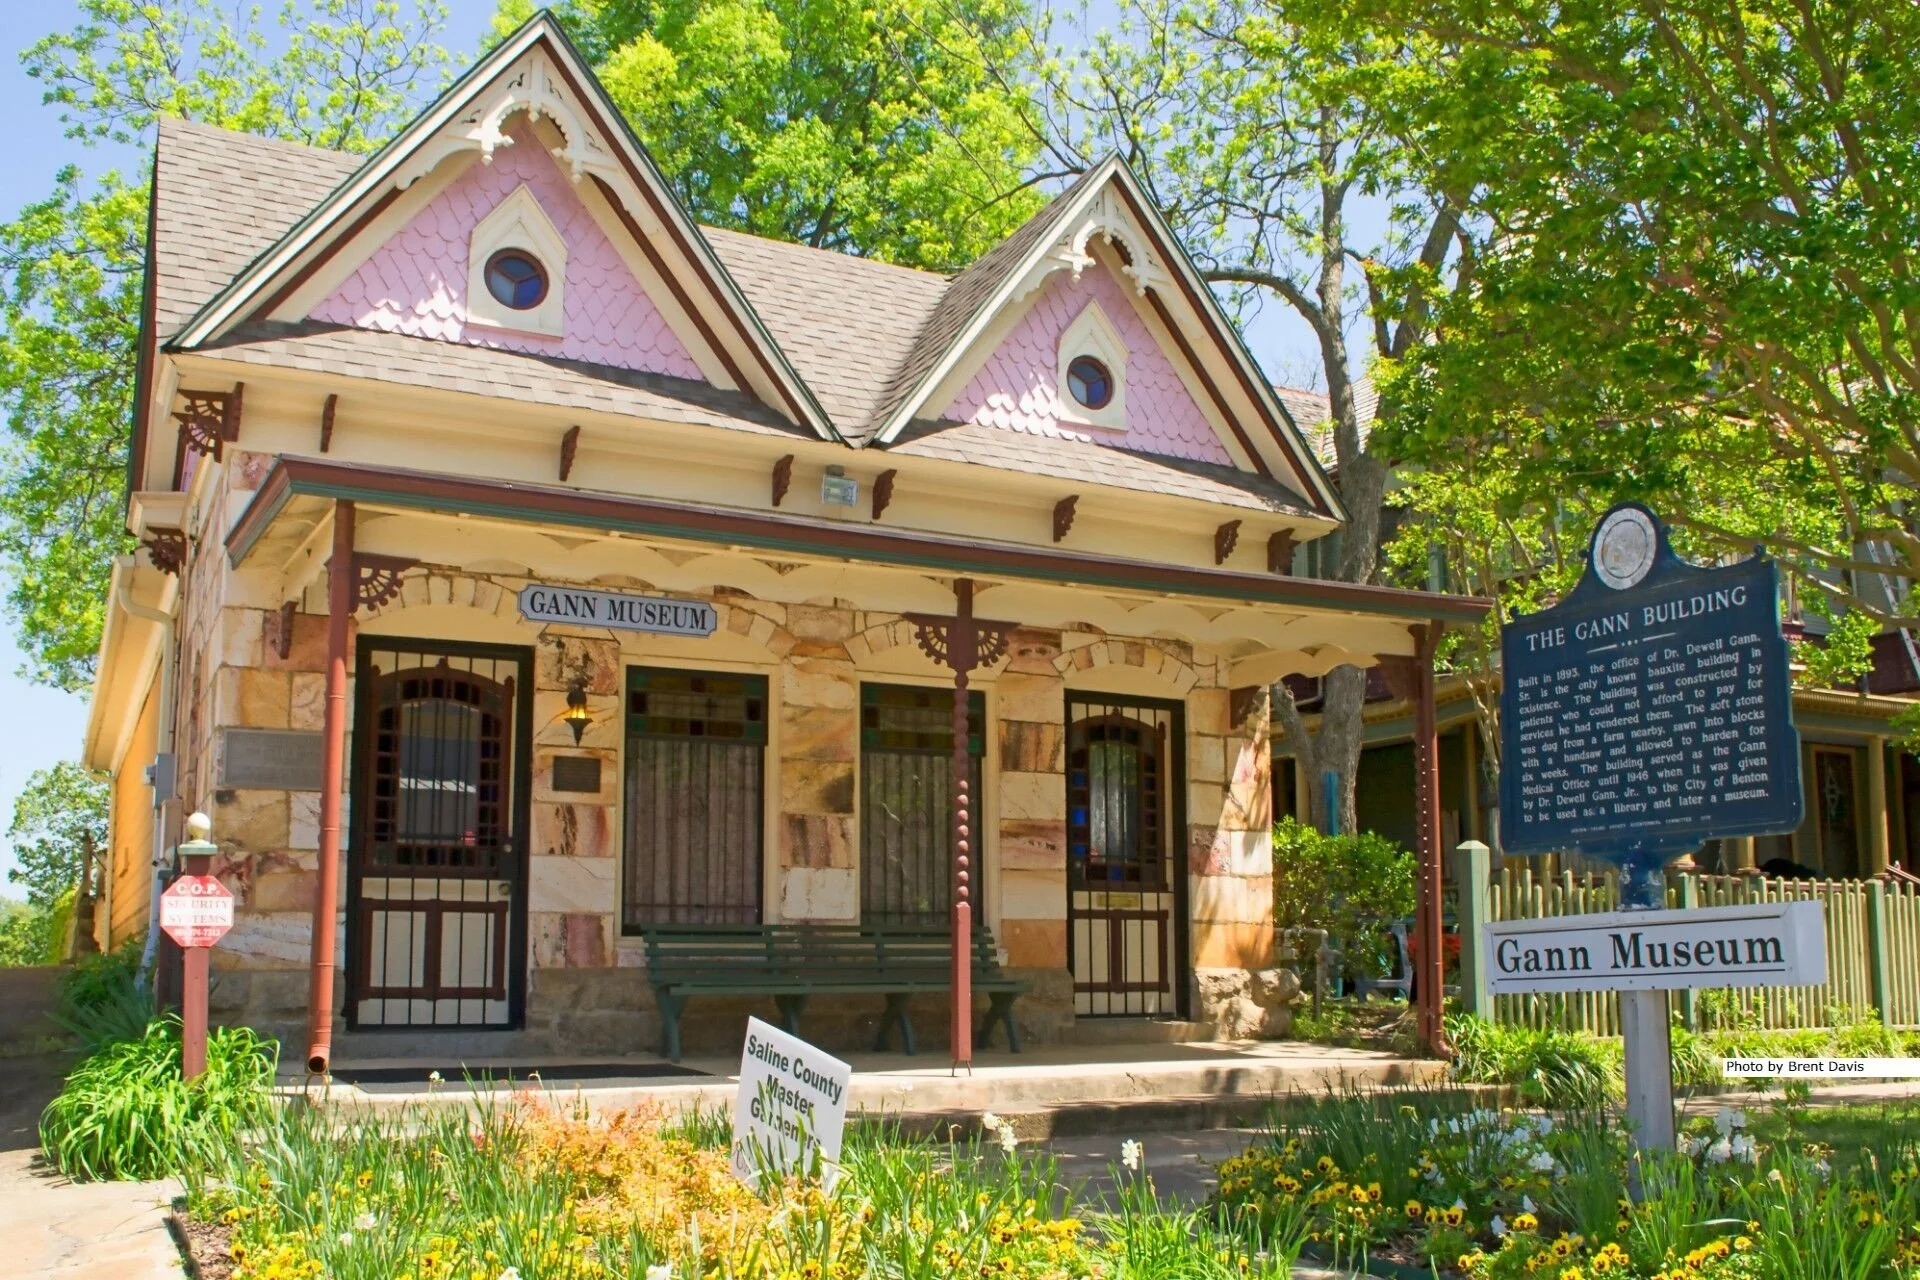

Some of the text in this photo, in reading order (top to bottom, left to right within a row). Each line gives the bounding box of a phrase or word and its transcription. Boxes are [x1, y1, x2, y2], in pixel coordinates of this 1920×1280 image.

[530, 591, 707, 630] GANN MUSEUM
[1526, 586, 1747, 651] THE GANN BUILDING
[1518, 676, 1539, 688] Built
[1543, 674, 1552, 683] in
[1590, 664, 1605, 674] the
[1611, 657, 1639, 670] office
[1647, 651, 1657, 663] of
[1664, 649, 1679, 660] Dr.
[1686, 639, 1723, 655] Dewell
[1518, 648, 1761, 701] Sr. is the only known bauxite building in
[1520, 663, 1762, 715] existence. The building was constructed by
[1520, 679, 1763, 730] patients who could not afford to pay for
[1520, 695, 1764, 741] services he had rendered them. The soft stone
[1521, 745, 1536, 754] was
[1542, 742, 1558, 753] dug
[1563, 738, 1585, 748] from
[1592, 736, 1598, 744] a
[1604, 732, 1624, 743] farm
[1673, 721, 1696, 732] sawn
[1704, 716, 1724, 727] into
[1731, 710, 1765, 723] blocks
[1521, 758, 1539, 768] with
[1564, 749, 1601, 763] handsaw
[1609, 745, 1626, 756] and
[1636, 738, 1673, 752] allowed
[1682, 736, 1692, 745] to
[1702, 729, 1739, 743] harden
[1749, 725, 1765, 736] for
[1522, 741, 1766, 782] six weeks. The building served as the Gann
[1522, 756, 1767, 795] Medical Office until 1946 when it was given
[1523, 800, 1534, 810] by
[1538, 797, 1551, 807] Dr.
[1556, 793, 1585, 805] Dewell
[1647, 785, 1657, 794] to
[1662, 782, 1679, 793] the
[1685, 779, 1706, 790] City
[1714, 776, 1724, 787] of
[1732, 772, 1768, 785] Benton
[1524, 814, 1533, 822] to
[1538, 812, 1550, 821] be
[1556, 809, 1577, 819] used
[1599, 806, 1605, 815] a
[1614, 802, 1647, 814] library
[1653, 798, 1671, 809] and
[1679, 795, 1703, 806] later
[1710, 794, 1717, 803] a
[1724, 788, 1769, 801] museum.
[176, 883, 220, 895] CO.P.
[168, 915, 227, 924] SYTEMS
[1497, 932, 1785, 974] Gann Museum
[747, 1034, 842, 1105] Saline County
[766, 1074, 815, 1117] Master
